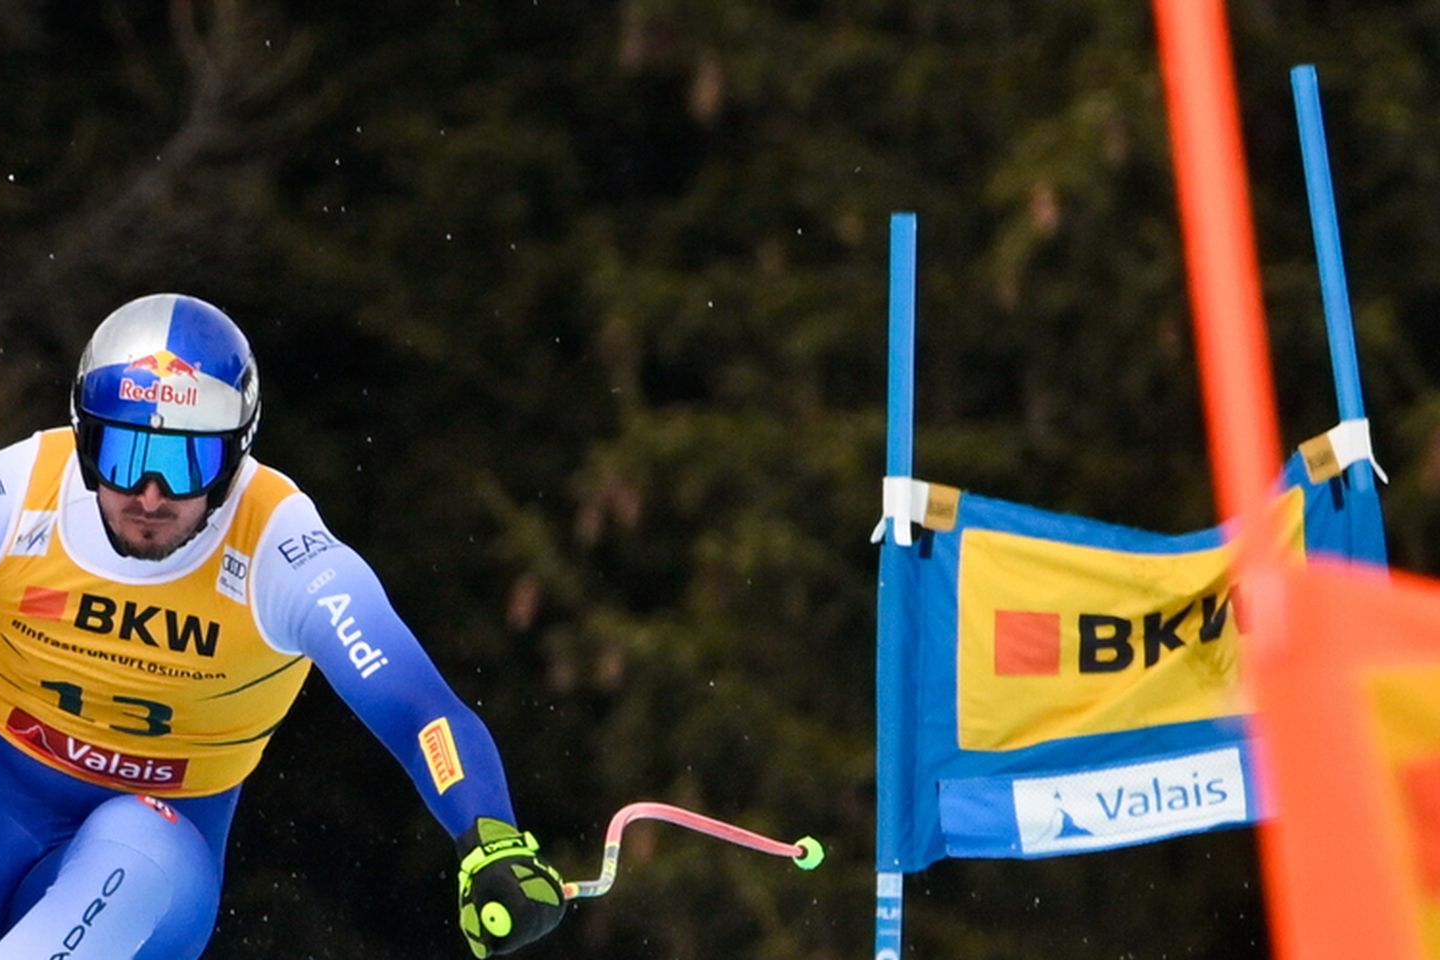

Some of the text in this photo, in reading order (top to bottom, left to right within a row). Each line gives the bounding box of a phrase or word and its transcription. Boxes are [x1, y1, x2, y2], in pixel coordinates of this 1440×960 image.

[120, 379, 198, 407] Red Bull
[74, 593, 220, 658] BKW
[317, 593, 389, 679] Audi
[40, 679, 174, 737] 13
[67, 736, 173, 781] Valais
[1096, 771, 1228, 820] Valais
